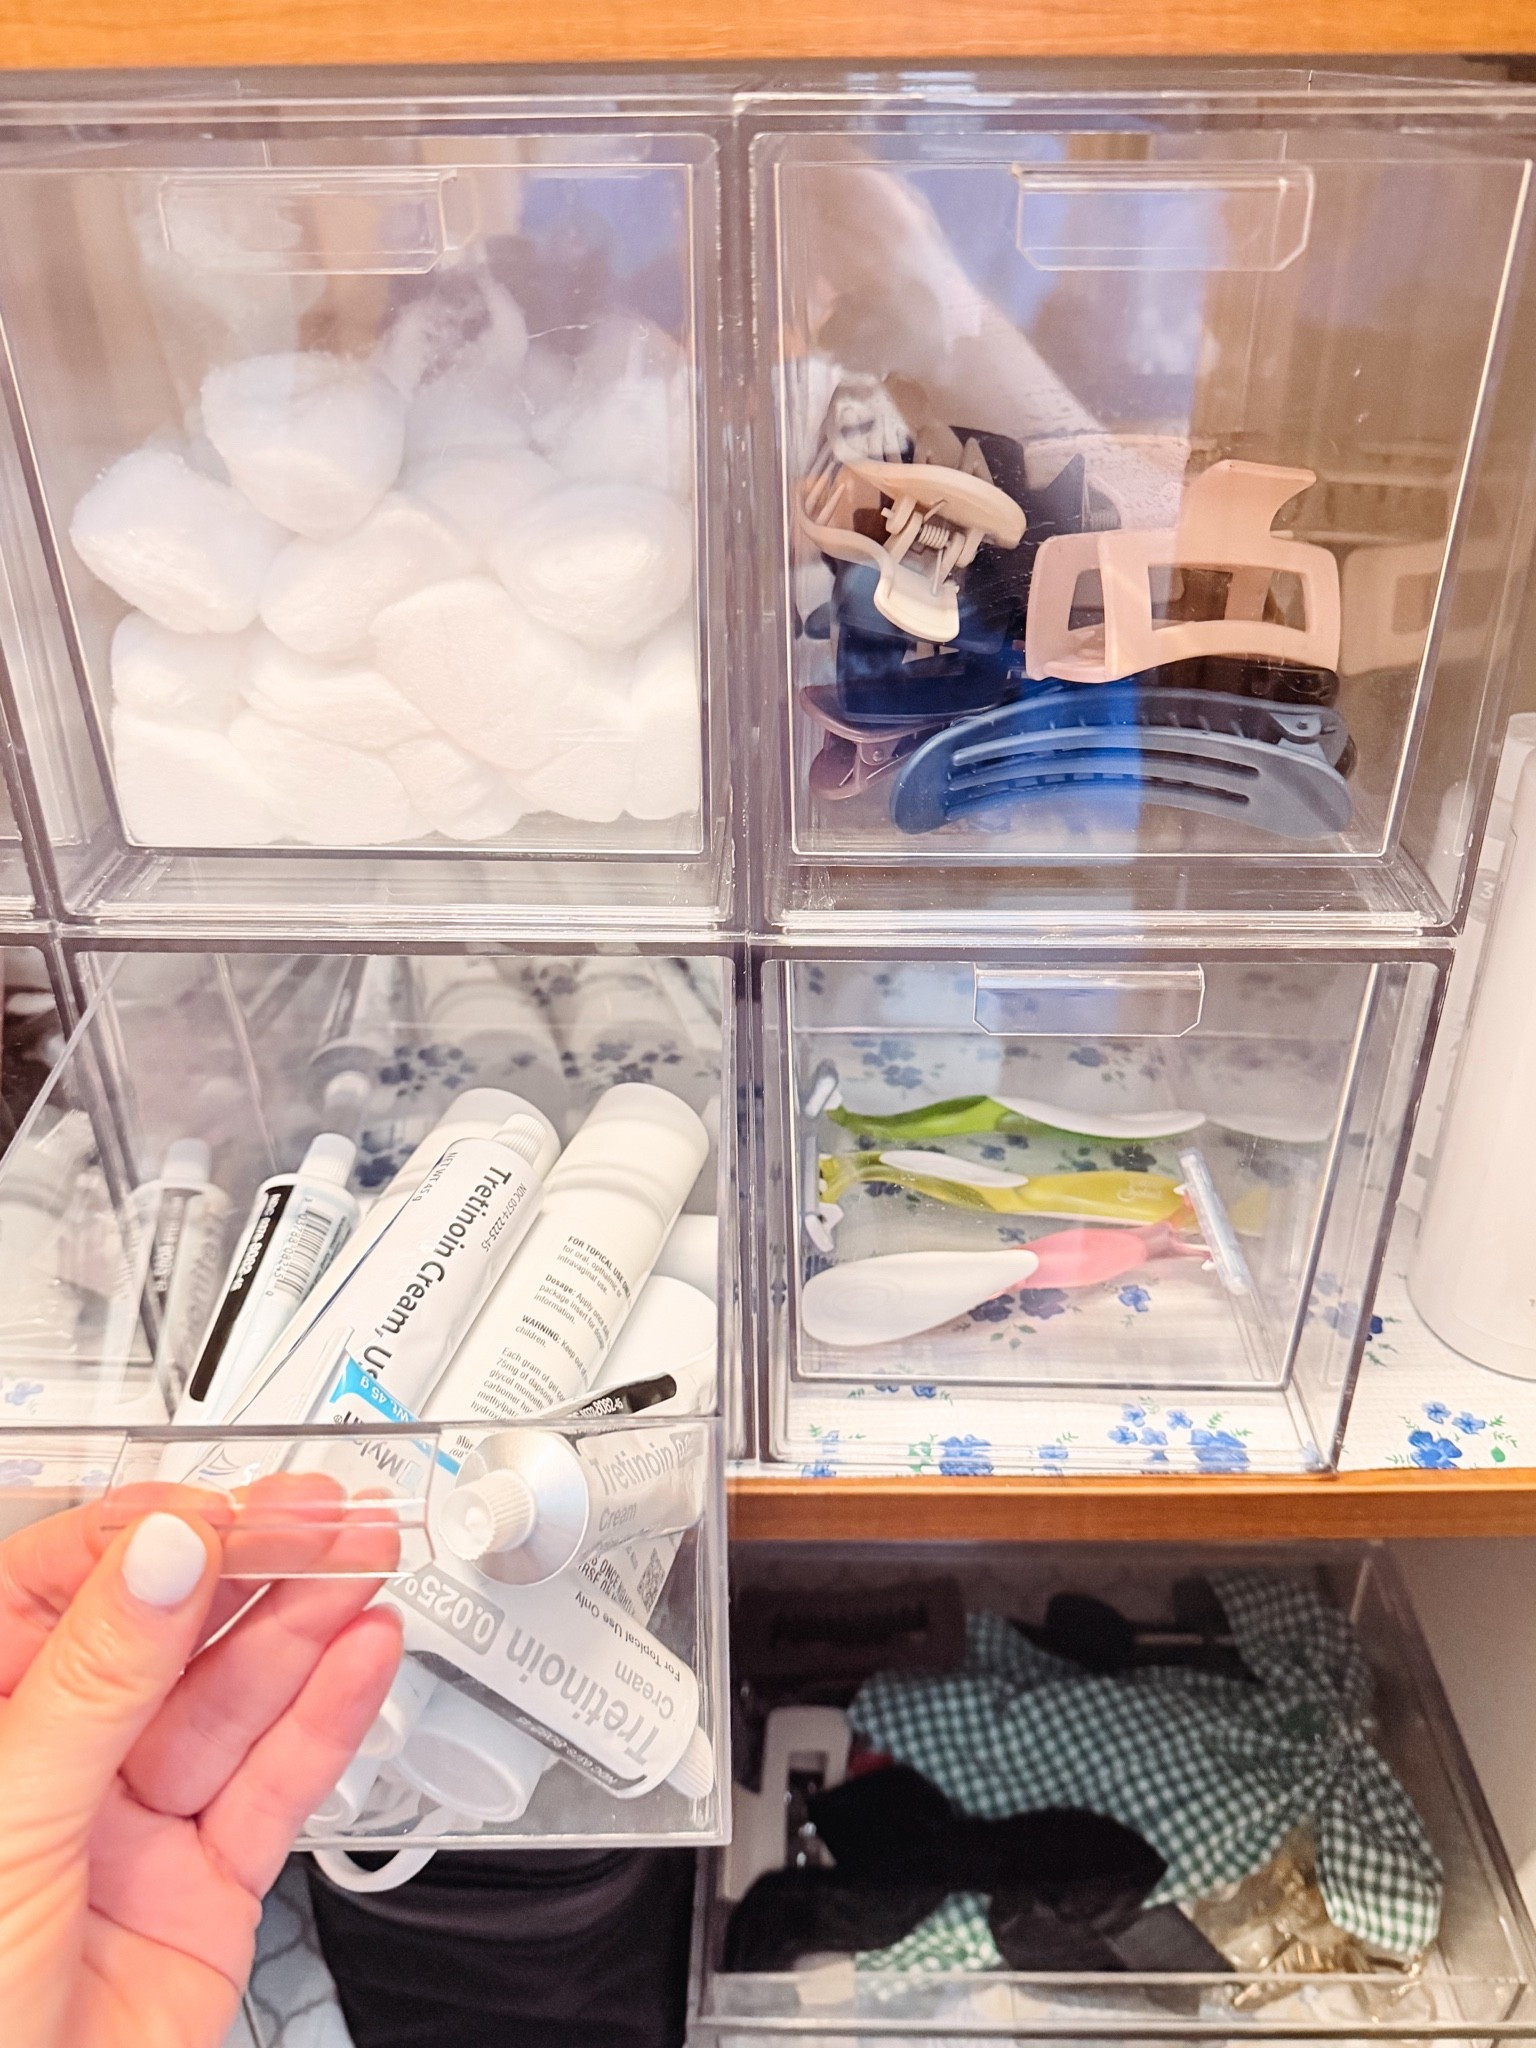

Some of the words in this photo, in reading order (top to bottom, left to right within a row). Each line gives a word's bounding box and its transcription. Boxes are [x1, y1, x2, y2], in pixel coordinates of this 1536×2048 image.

[420, 1183, 433, 1194] 45
[429, 1167, 445, 1182] WT
[513, 1182, 527, 1203] NDC
[433, 1165, 511, 1258] Tretinoin
[562, 1244, 574, 1254] for
[567, 1235, 585, 1249] FOR
[585, 1243, 613, 1270] TOPICAL
[612, 1266, 624, 1283] USE
[556, 1253, 598, 1283] intravaginal
[374, 1262, 444, 1338] Cream,
[538, 1284, 570, 1305] package
[569, 1301, 589, 1320] insert
[544, 1273, 577, 1296] Dosage:
[575, 1292, 593, 1312] Apply
[533, 1292, 576, 1325] information.
[514, 1324, 547, 1348] children.
[521, 1313, 562, 1344] WARNING:
[560, 1339, 576, 1359] Keep
[488, 1367, 514, 1385] glycol
[501, 1346, 520, 1361] Each
[520, 1358, 542, 1376] gram
[357, 1375, 372, 1390] g
[368, 1386, 387, 1404] 45
[483, 1378, 520, 1404] carbomer
[588, 1441, 675, 1496] Tretinoin
[597, 1501, 636, 1531] Cream
[574, 1590, 601, 1618] Only
[600, 1611, 625, 1636] Use
[623, 1629, 662, 1667] Topical
[663, 1661, 682, 1682] For
[501, 1626, 660, 1766] Tretinoin
[609, 1659, 676, 1717] Cream
